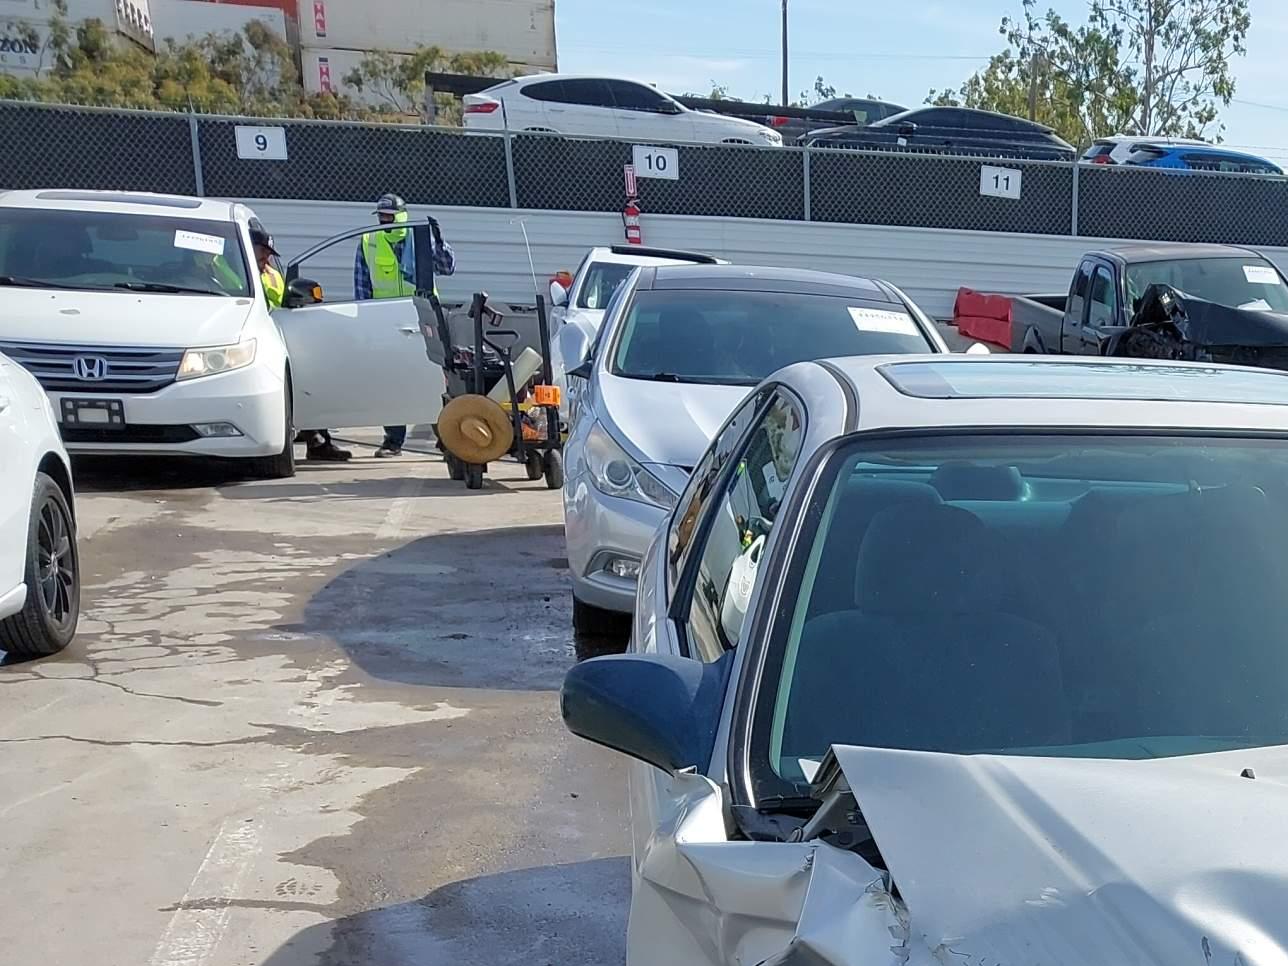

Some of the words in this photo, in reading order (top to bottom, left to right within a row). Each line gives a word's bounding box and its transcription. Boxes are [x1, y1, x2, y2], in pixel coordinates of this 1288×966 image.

[254, 134, 268, 152] 9
[644, 153, 667, 171] 10
[992, 174, 1010, 191] 11
